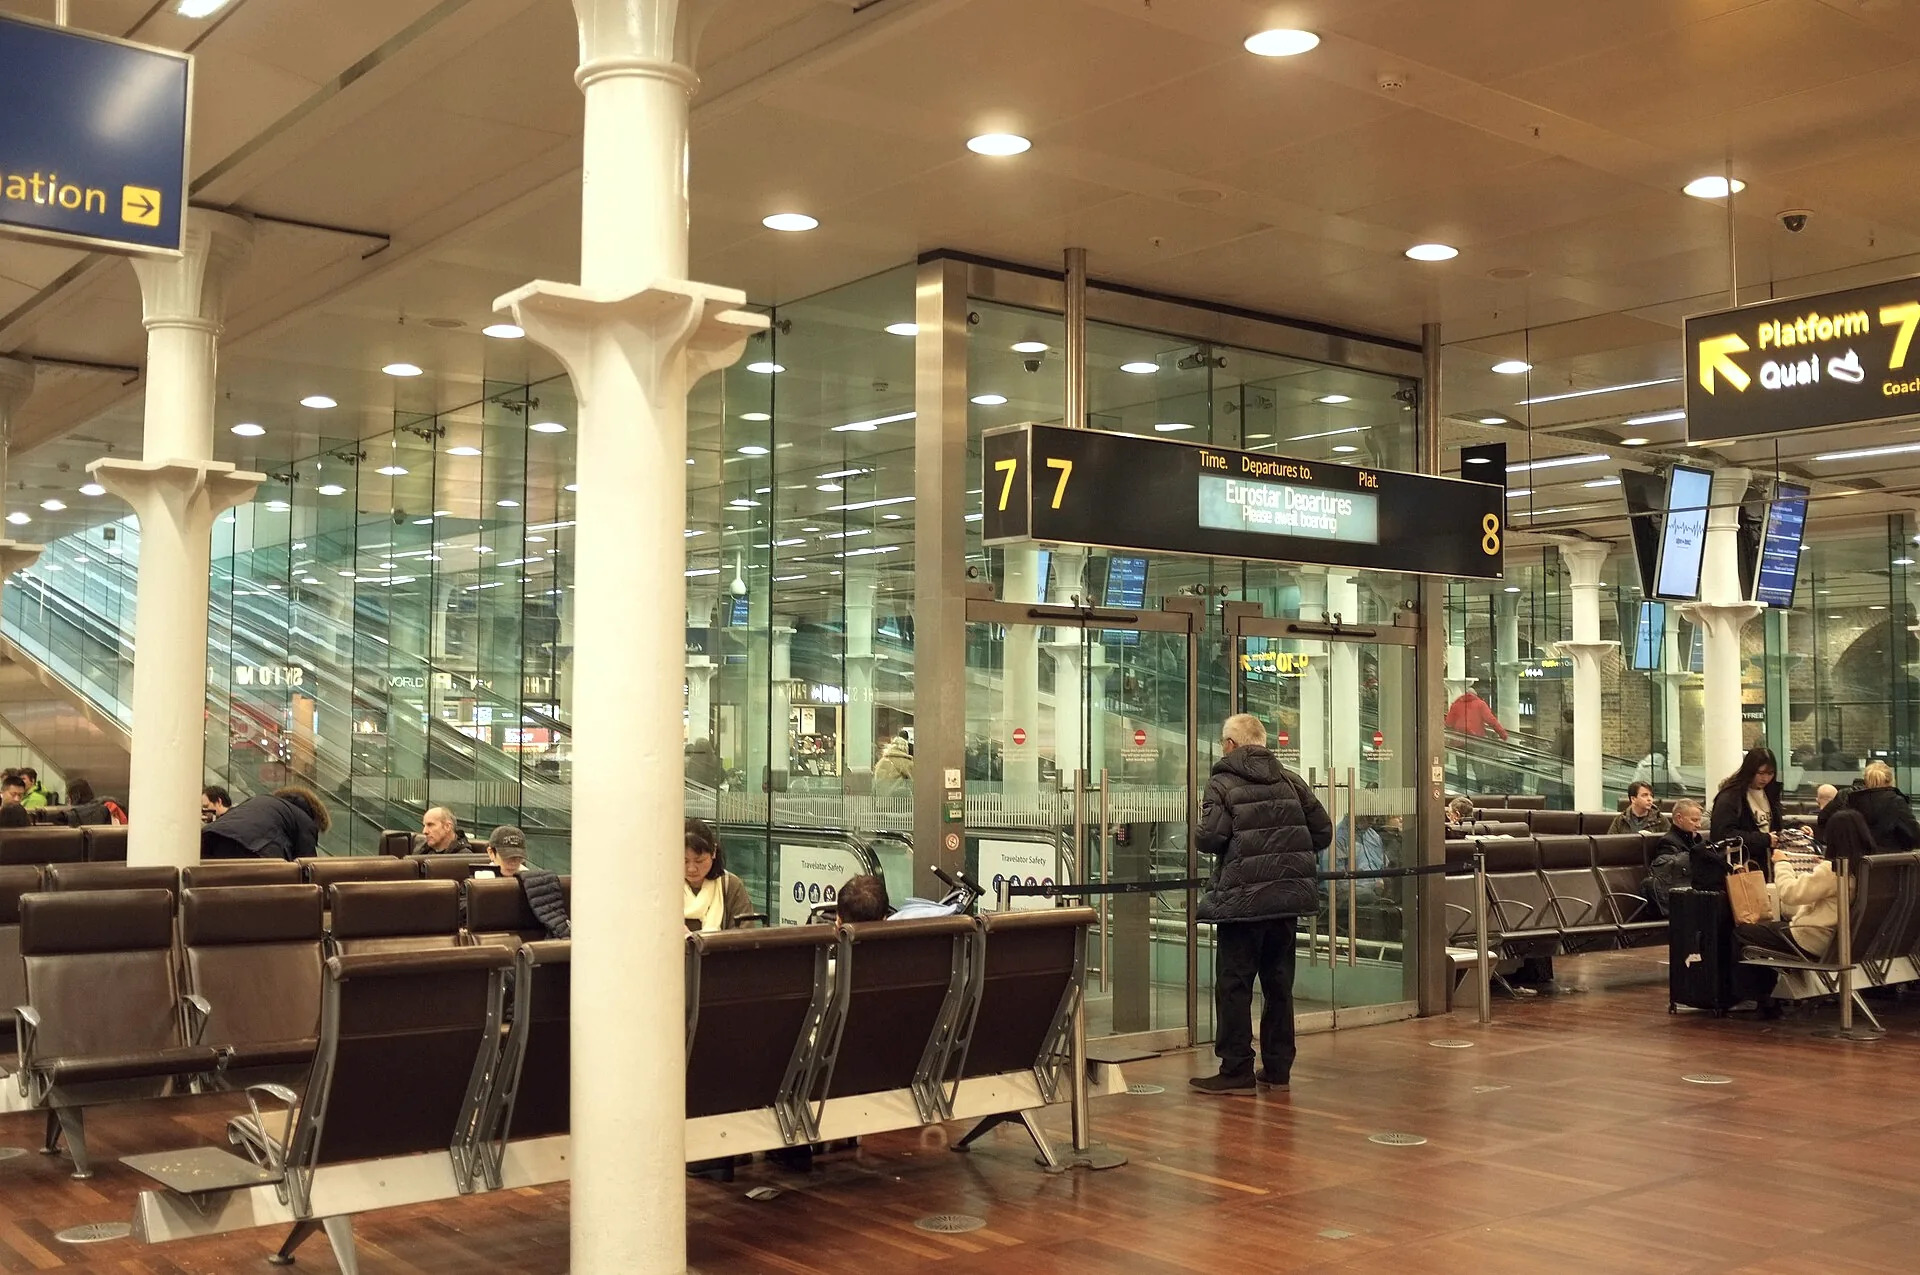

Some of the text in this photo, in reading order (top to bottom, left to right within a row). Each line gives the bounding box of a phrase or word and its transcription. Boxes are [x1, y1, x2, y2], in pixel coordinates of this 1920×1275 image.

[0, 172, 106, 214] ation
[1758, 300, 1920, 370] Platform 7
[1759, 352, 1820, 390] Quai
[994, 457, 1017, 511] 7
[1046, 457, 1073, 510] 7
[1200, 450, 1379, 488] Time. Departures to. Plat.
[1225, 479, 1353, 516] Eurostar Departures
[1242, 505, 1273, 523] Please
[1481, 512, 1500, 556] 8
[801, 860, 845, 875] Travelator Safety
[1001, 853, 1047, 867] Travelator Safety
